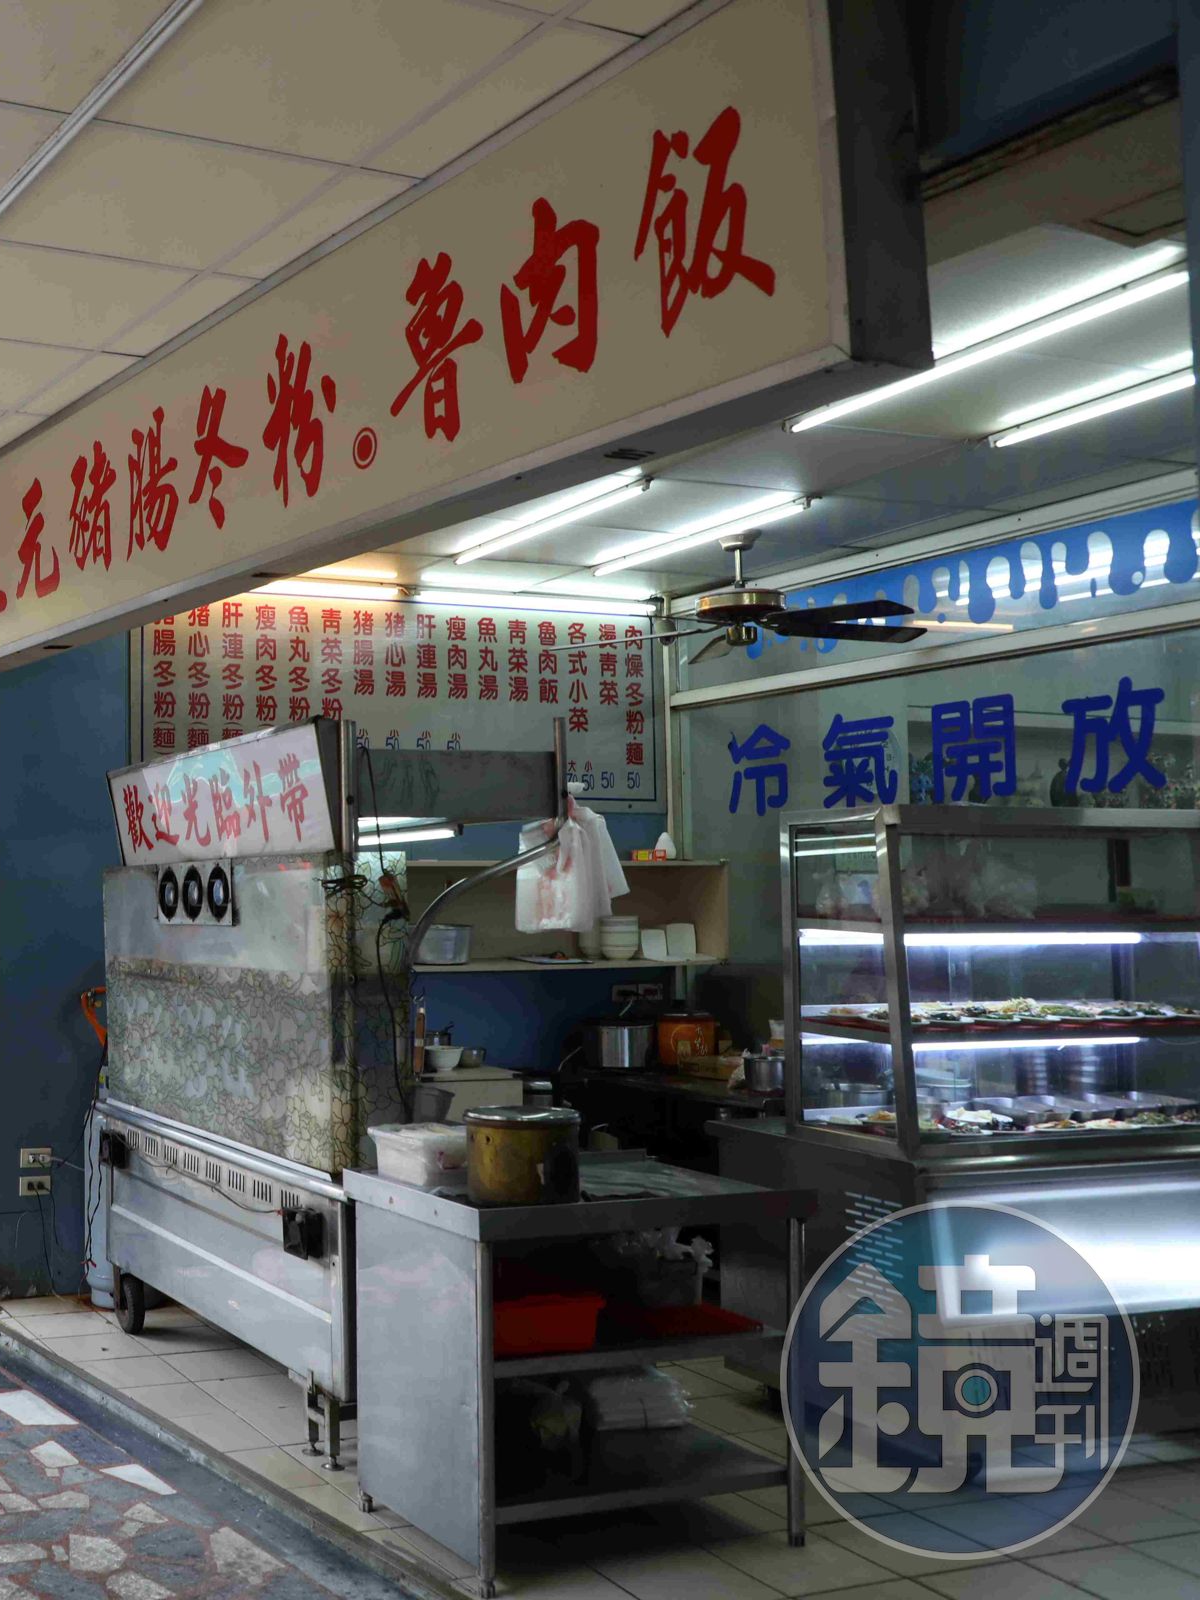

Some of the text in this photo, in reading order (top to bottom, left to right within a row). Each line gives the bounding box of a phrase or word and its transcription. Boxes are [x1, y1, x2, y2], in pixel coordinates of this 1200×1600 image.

[391, 106, 776, 441] 魯肉飯
[416, 614, 438, 699] 肝連湯
[445, 615, 468, 700] 瘦肉湯
[477, 617, 499, 701] 魚丸湯
[507, 619, 529, 702] 青菜湯
[537, 621, 559, 705] 魯肉飯
[567, 622, 589, 733] 各式小菜
[601, 771, 615, 789] 50
[627, 772, 640, 789] 50
[728, 677, 1166, 817] 冷氣開放
[123, 753, 309, 853] 歡迎光臨外帶
